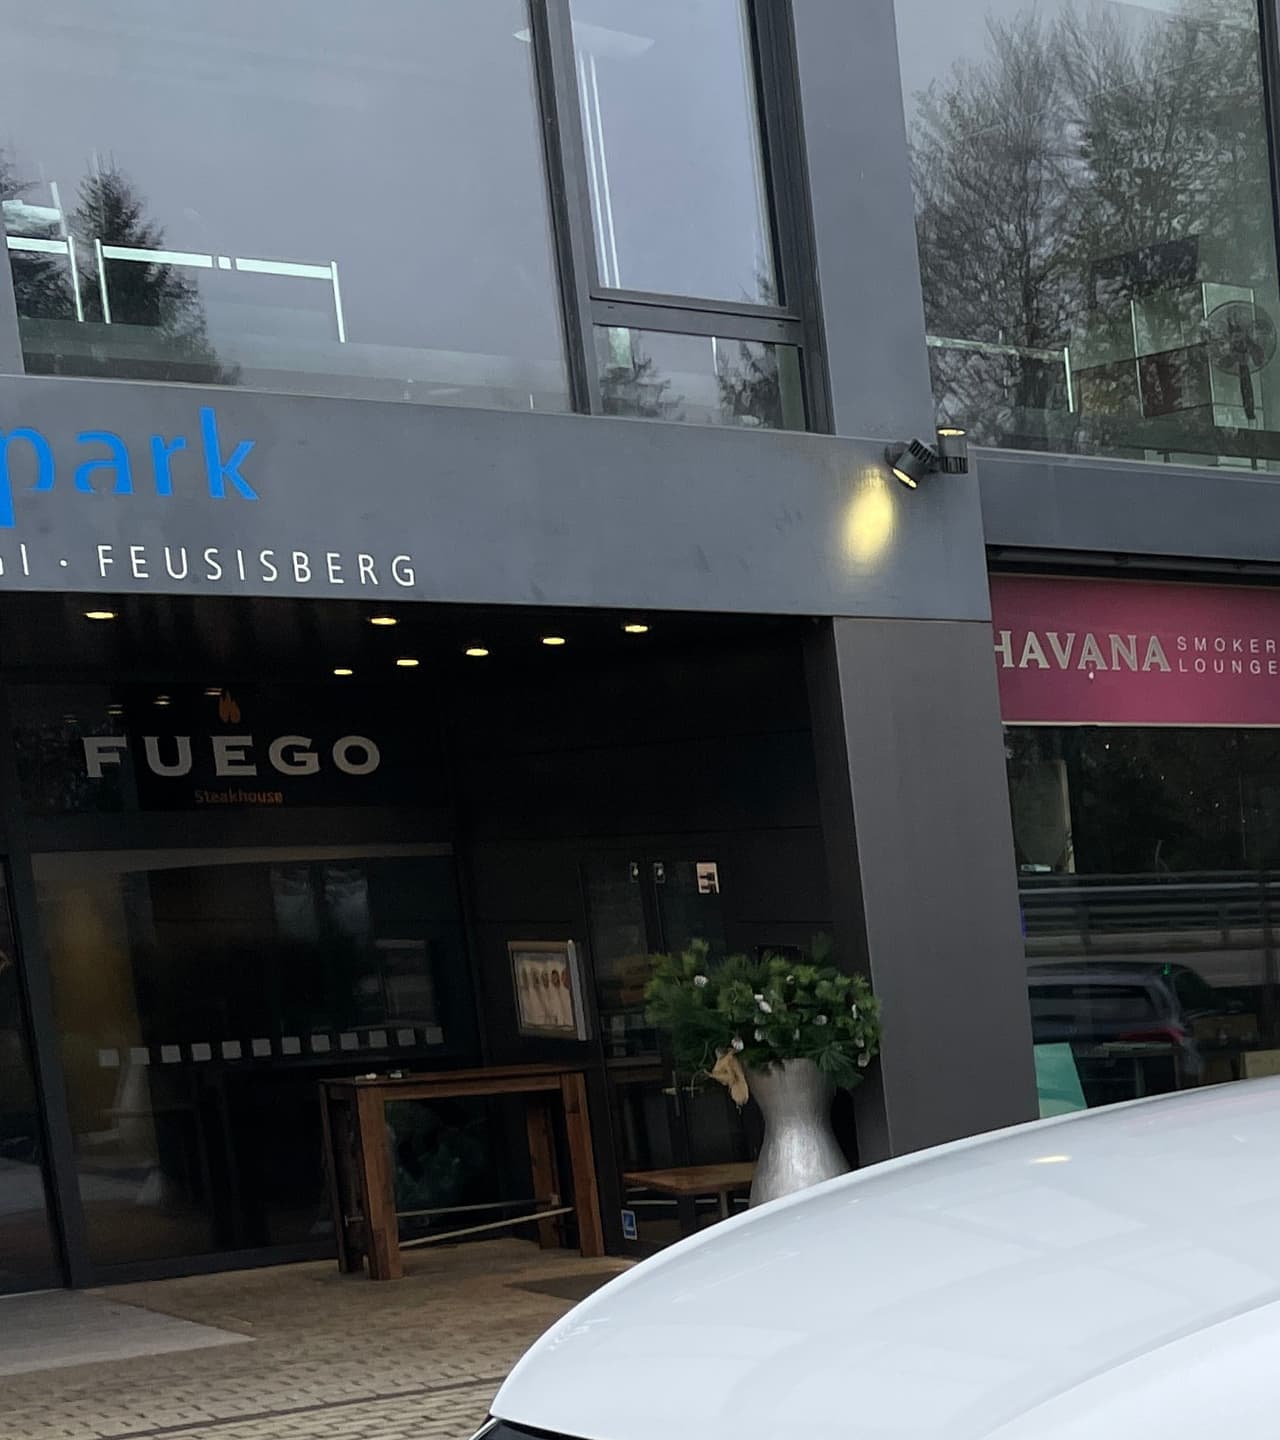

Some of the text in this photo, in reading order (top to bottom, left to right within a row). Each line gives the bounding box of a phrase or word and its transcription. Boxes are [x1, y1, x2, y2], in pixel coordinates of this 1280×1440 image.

[98, 544, 416, 588] FEUSISBERG
[993, 630, 1172, 672] HAVANA
[1177, 636, 1277, 653] SMOKER
[1178, 658, 1279, 675] LOUNGE
[82, 735, 381, 778] FUEGO
[194, 788, 284, 804] Steakhouse
